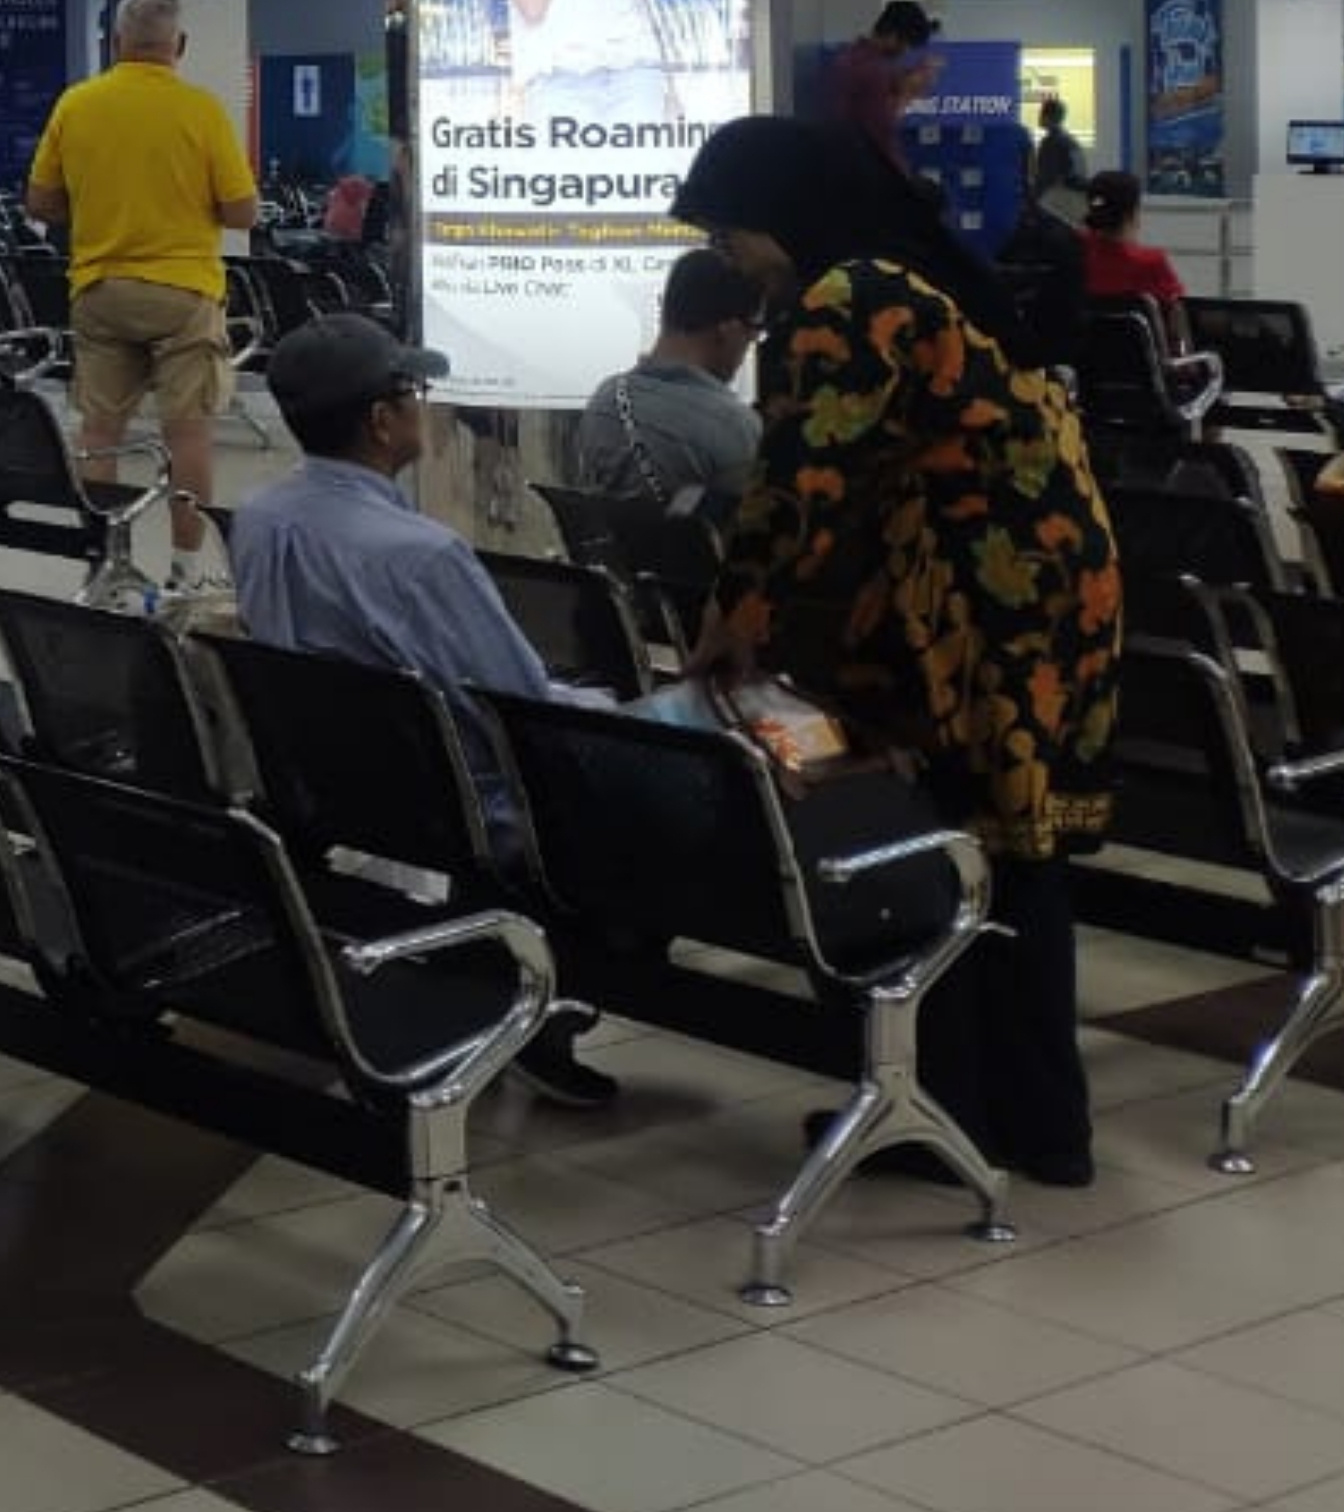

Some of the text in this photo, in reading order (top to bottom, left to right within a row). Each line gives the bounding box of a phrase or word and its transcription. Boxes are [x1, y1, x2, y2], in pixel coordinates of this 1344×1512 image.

[432, 116, 536, 148] Gratis
[432, 165, 680, 206] di Singapura
